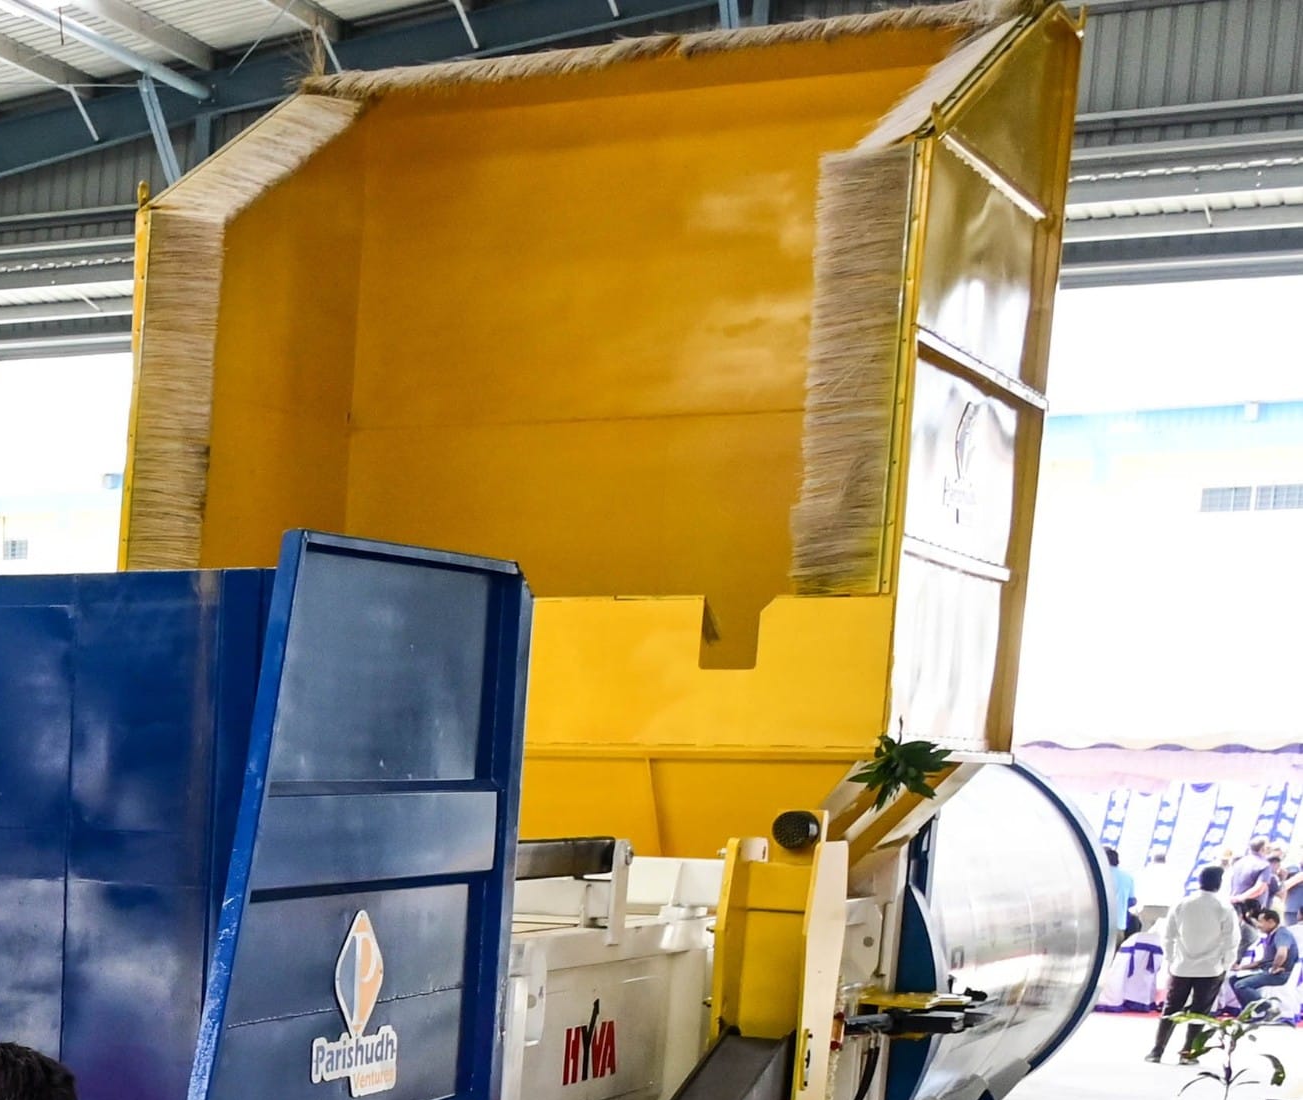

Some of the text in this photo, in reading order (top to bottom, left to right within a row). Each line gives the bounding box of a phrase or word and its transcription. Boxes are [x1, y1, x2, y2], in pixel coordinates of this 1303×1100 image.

[314, 1032, 395, 1075] Parishudh
[562, 998, 617, 1086] HYVA
[353, 1067, 395, 1089] Ventures
